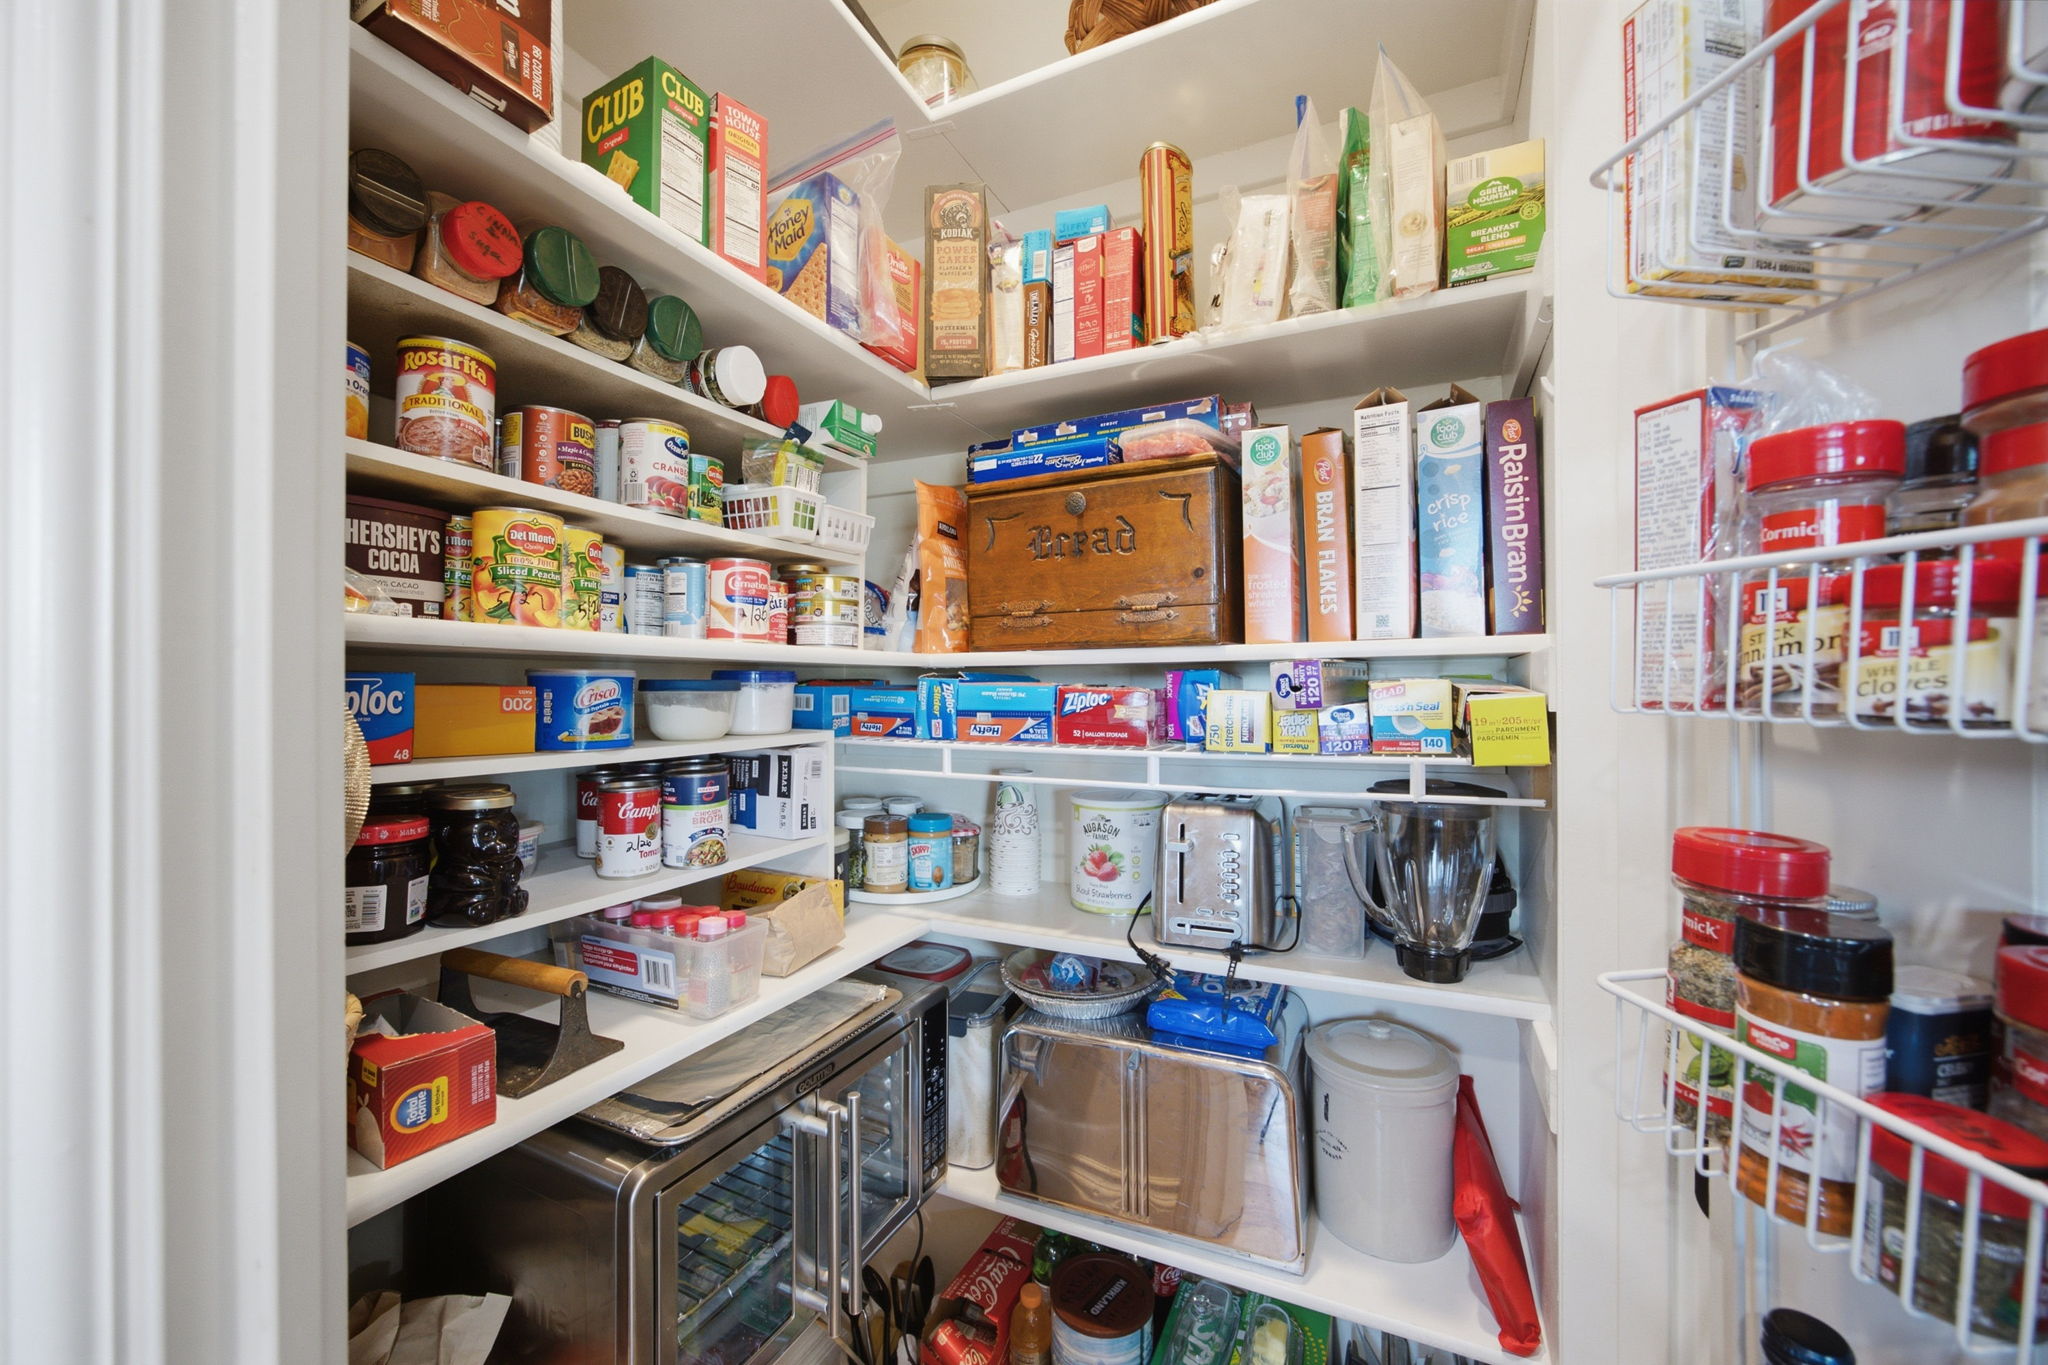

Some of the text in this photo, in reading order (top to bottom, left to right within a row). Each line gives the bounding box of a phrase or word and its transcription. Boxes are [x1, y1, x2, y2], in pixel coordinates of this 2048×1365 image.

[532, 45, 543, 101] 66 COOKIES
[661, 71, 705, 117] CLUB
[1626, 70, 1635, 111] DELICIOUS
[587, 78, 644, 144] CLUB
[725, 106, 761, 131] TOWN
[724, 116, 761, 142] HOUSE
[603, 135, 624, 150] Original
[727, 130, 758, 150] ORIGINAL
[1472, 188, 1518, 205] MOUNTAIN
[1479, 184, 1510, 196] GREEN
[767, 206, 811, 240] Honey
[1471, 221, 1521, 238] BREAKFAST
[774, 225, 806, 255] Maid
[940, 227, 974, 239] KODIAK
[1480, 231, 1510, 243] BLEND
[936, 246, 977, 255] POWER
[937, 255, 977, 264] CAKES
[1031, 327, 1040, 368] Gnocchi
[404, 351, 488, 386] Rosarita
[410, 397, 480, 419] TRADITIONAL
[1436, 422, 1459, 433] food
[1507, 422, 1520, 441] Post
[1437, 430, 1458, 441] club
[1255, 442, 1275, 451] food
[1255, 448, 1275, 459] club
[1033, 454, 1044, 464] 22
[1316, 461, 1332, 483] Post
[1427, 492, 1472, 515] crisp
[1498, 444, 1530, 583] Raisin Bran
[1433, 512, 1469, 532] rice
[345, 517, 441, 555] HERSHEY'S
[510, 529, 556, 546] Del Monte
[1027, 515, 1137, 562] Bread
[524, 543, 545, 552] Quality
[1316, 490, 1338, 615] BRAN FLAKES
[368, 549, 420, 574] COCOA
[510, 556, 556, 569] 100% JUICE
[497, 565, 529, 577] Sliced
[390, 580, 419, 590] CACAO
[580, 579, 597, 590] Fruit
[728, 575, 770, 591] Carnation
[1248, 578, 1288, 589] frosted
[1306, 665, 1312, 675] SQ
[1312, 666, 1318, 675] FT
[580, 686, 617, 707] Crisco
[1307, 677, 1320, 704] 120
[1373, 686, 1404, 699] GLAD
[502, 697, 533, 712] 200
[933, 684, 941, 716] Slider
[942, 683, 954, 714] Ziploc
[1062, 692, 1109, 714] Ziploc
[1415, 701, 1440, 711] Seal
[860, 722, 883, 732] Hefty
[1277, 713, 1313, 727] Paper
[1474, 716, 1522, 726] 19 205
[971, 725, 1000, 736] Hefty
[1073, 730, 1081, 738] 52
[1209, 724, 1220, 745] 750
[1280, 725, 1307, 737] Wax
[1495, 725, 1541, 733] PARCHMENT
[1423, 738, 1443, 748] 140
[1477, 734, 1520, 742] PARCHEMIN
[1326, 741, 1352, 752] 120
[393, 749, 410, 760] 48
[781, 761, 789, 793] RXBAR
[694, 809, 721, 817] CHICKEN
[781, 802, 787, 813] No
[692, 815, 723, 826] BROTH
[1083, 823, 1120, 838] AUGASON
[639, 849, 661, 859] Toma
[910, 845, 931, 857] SKIPPY
[726, 873, 777, 896] Bauducco
[1092, 889, 1132, 900] Strawberries
[407, 1097, 418, 1126] Total
[417, 1090, 427, 1124] Home
[1090, 1279, 1128, 1316] KIRKLAND
